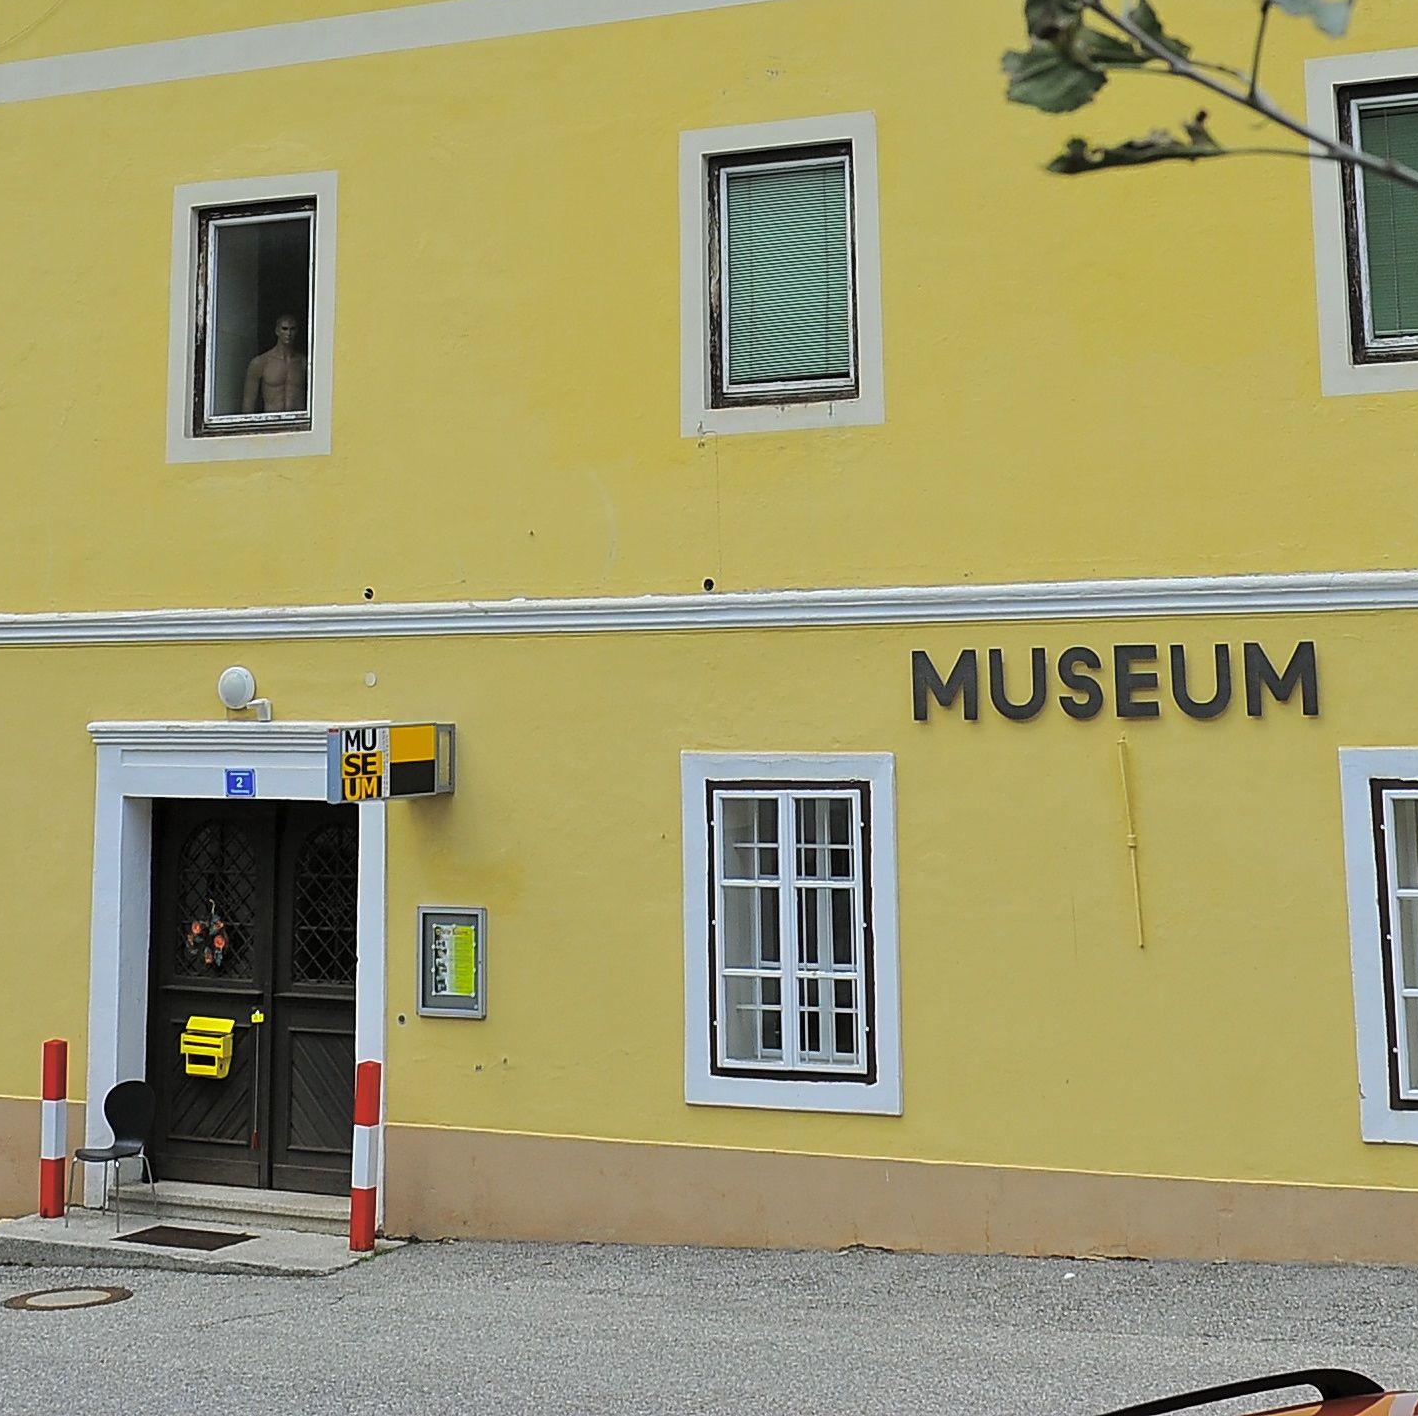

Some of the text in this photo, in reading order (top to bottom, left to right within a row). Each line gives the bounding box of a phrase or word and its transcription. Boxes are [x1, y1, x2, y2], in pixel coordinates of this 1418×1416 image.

[911, 641, 1320, 722] MUSEUM
[344, 727, 377, 753] MU
[344, 752, 378, 777] SE
[235, 776, 244, 788] 2
[344, 776, 378, 801] UM
